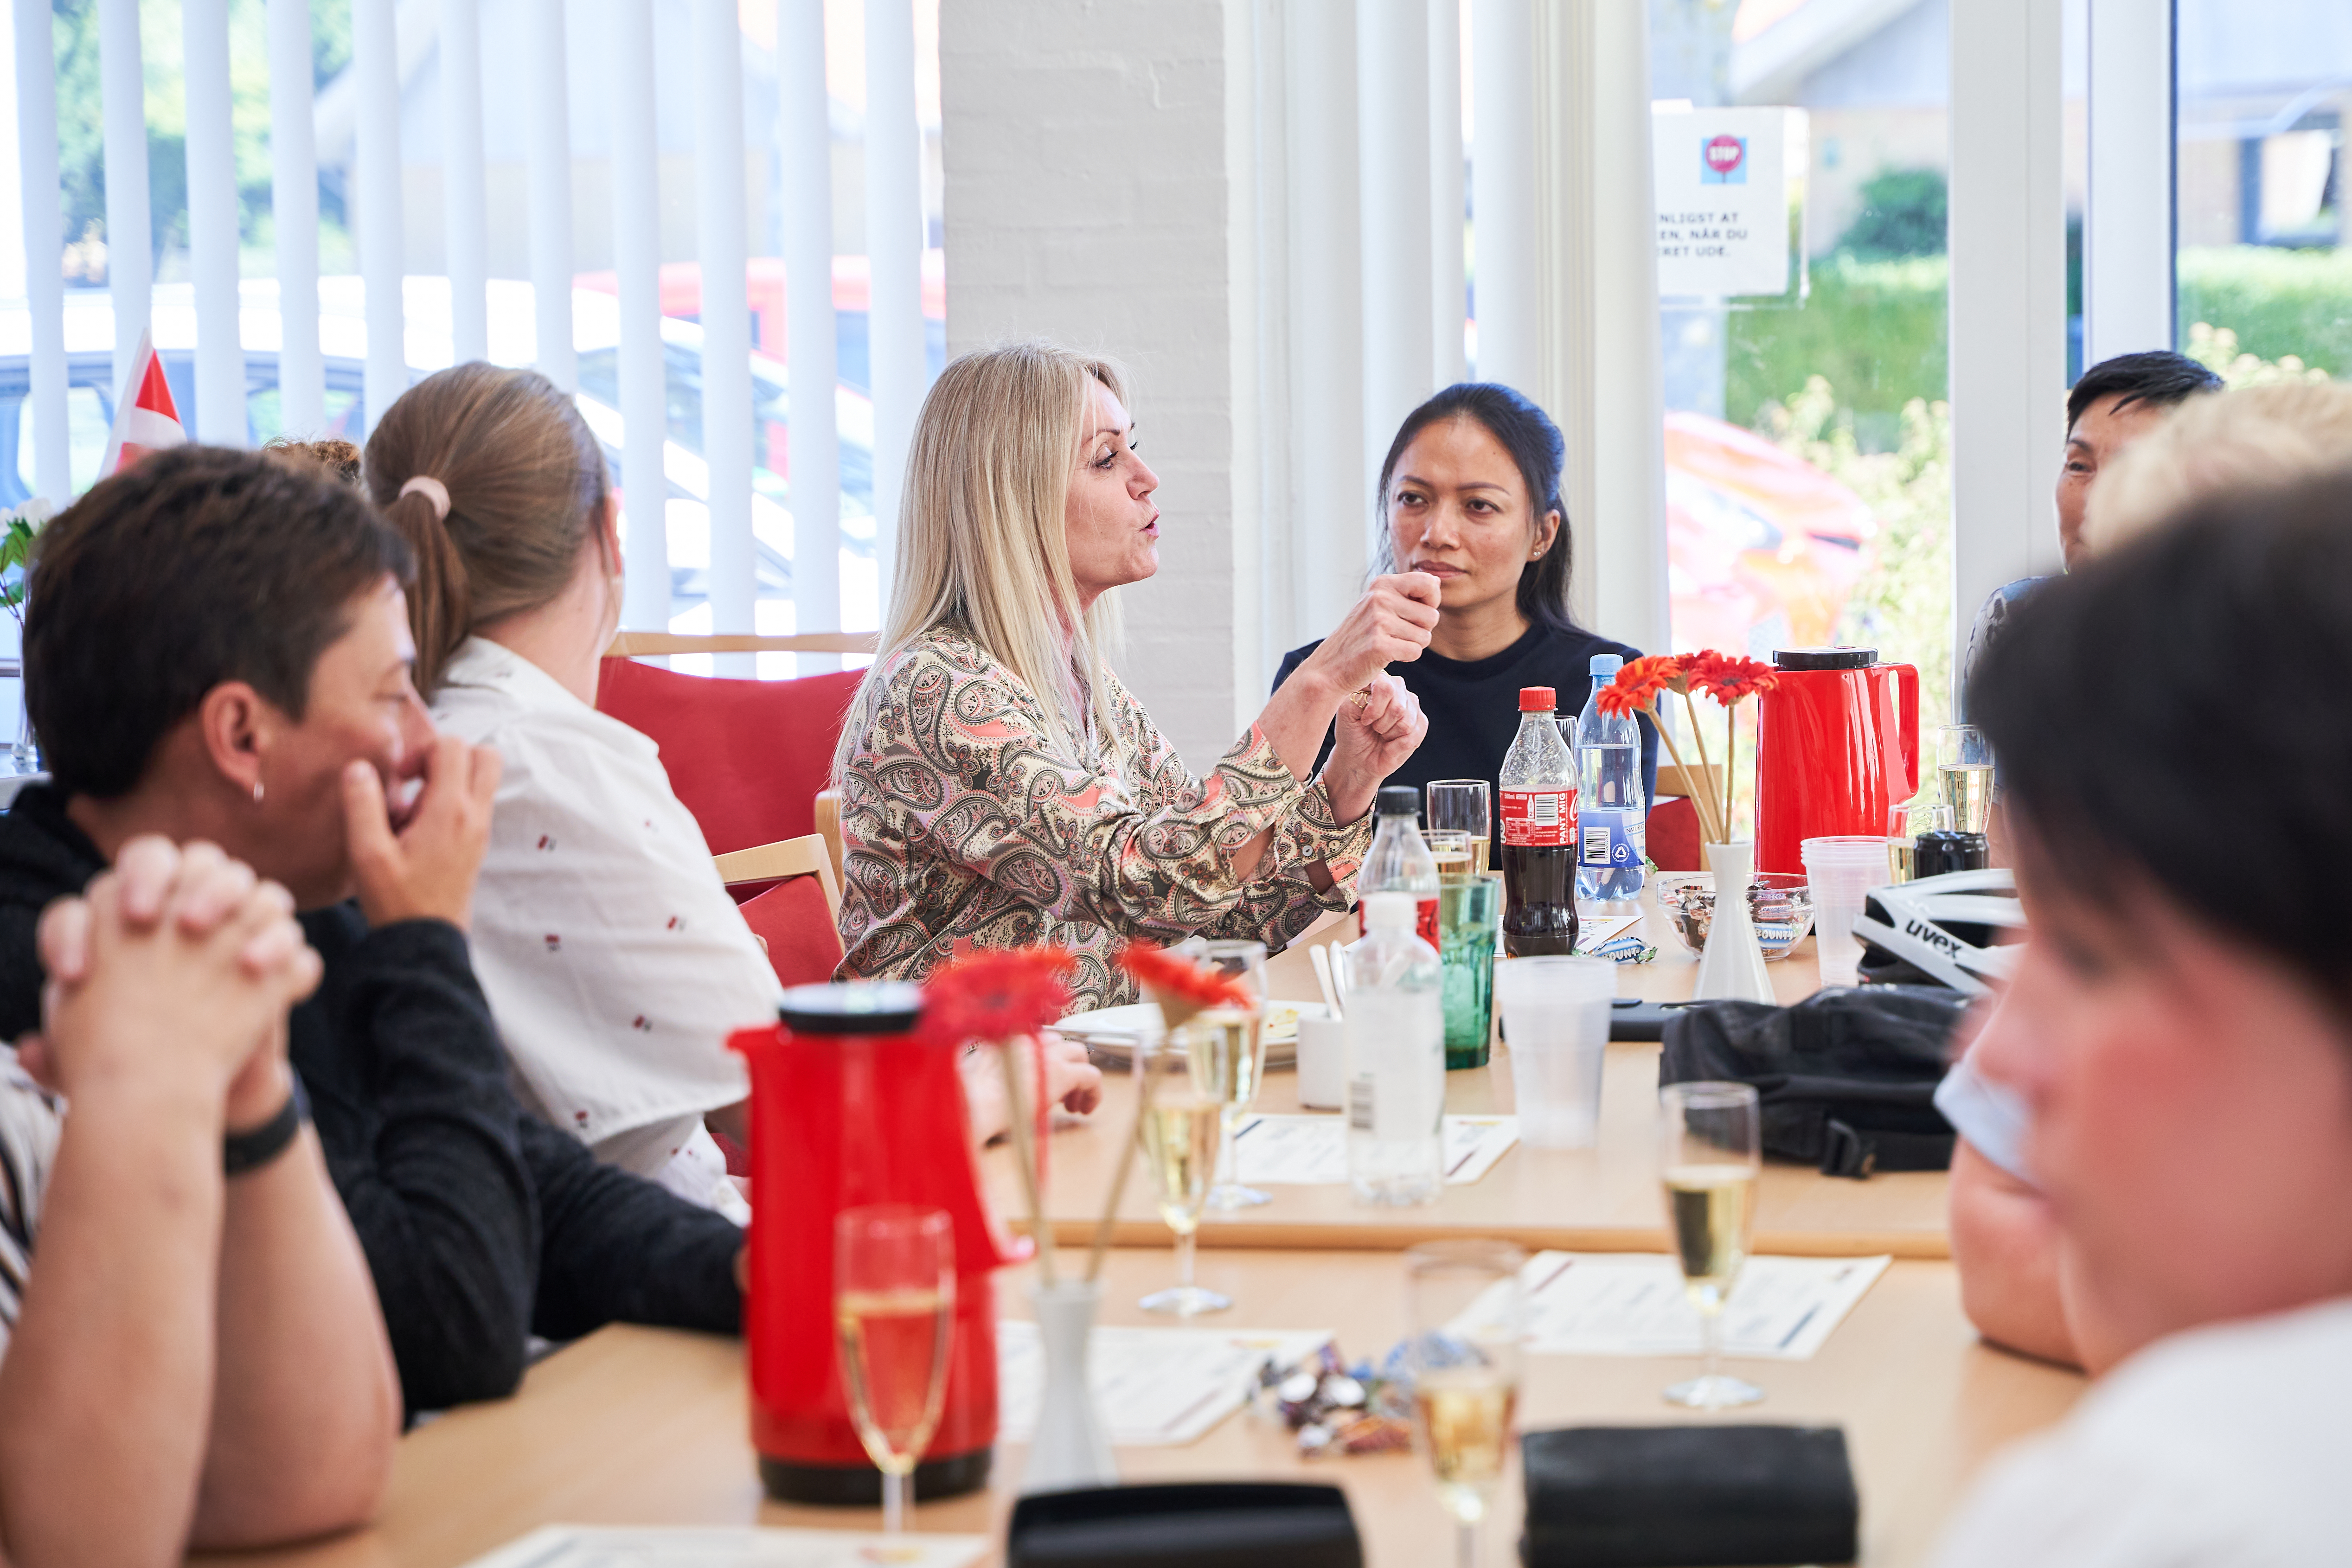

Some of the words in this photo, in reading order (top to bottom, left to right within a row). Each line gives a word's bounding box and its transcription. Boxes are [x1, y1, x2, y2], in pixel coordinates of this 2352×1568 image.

[1708, 146, 1740, 161] STOP
[1720, 212, 1738, 224] AT
[1690, 227, 1720, 240] NÅR
[1727, 230, 1748, 240] DU
[1696, 246, 1731, 257] UDE.
[1755, 928, 1794, 941] BOUNTY
[1906, 919, 1962, 959] uvex
